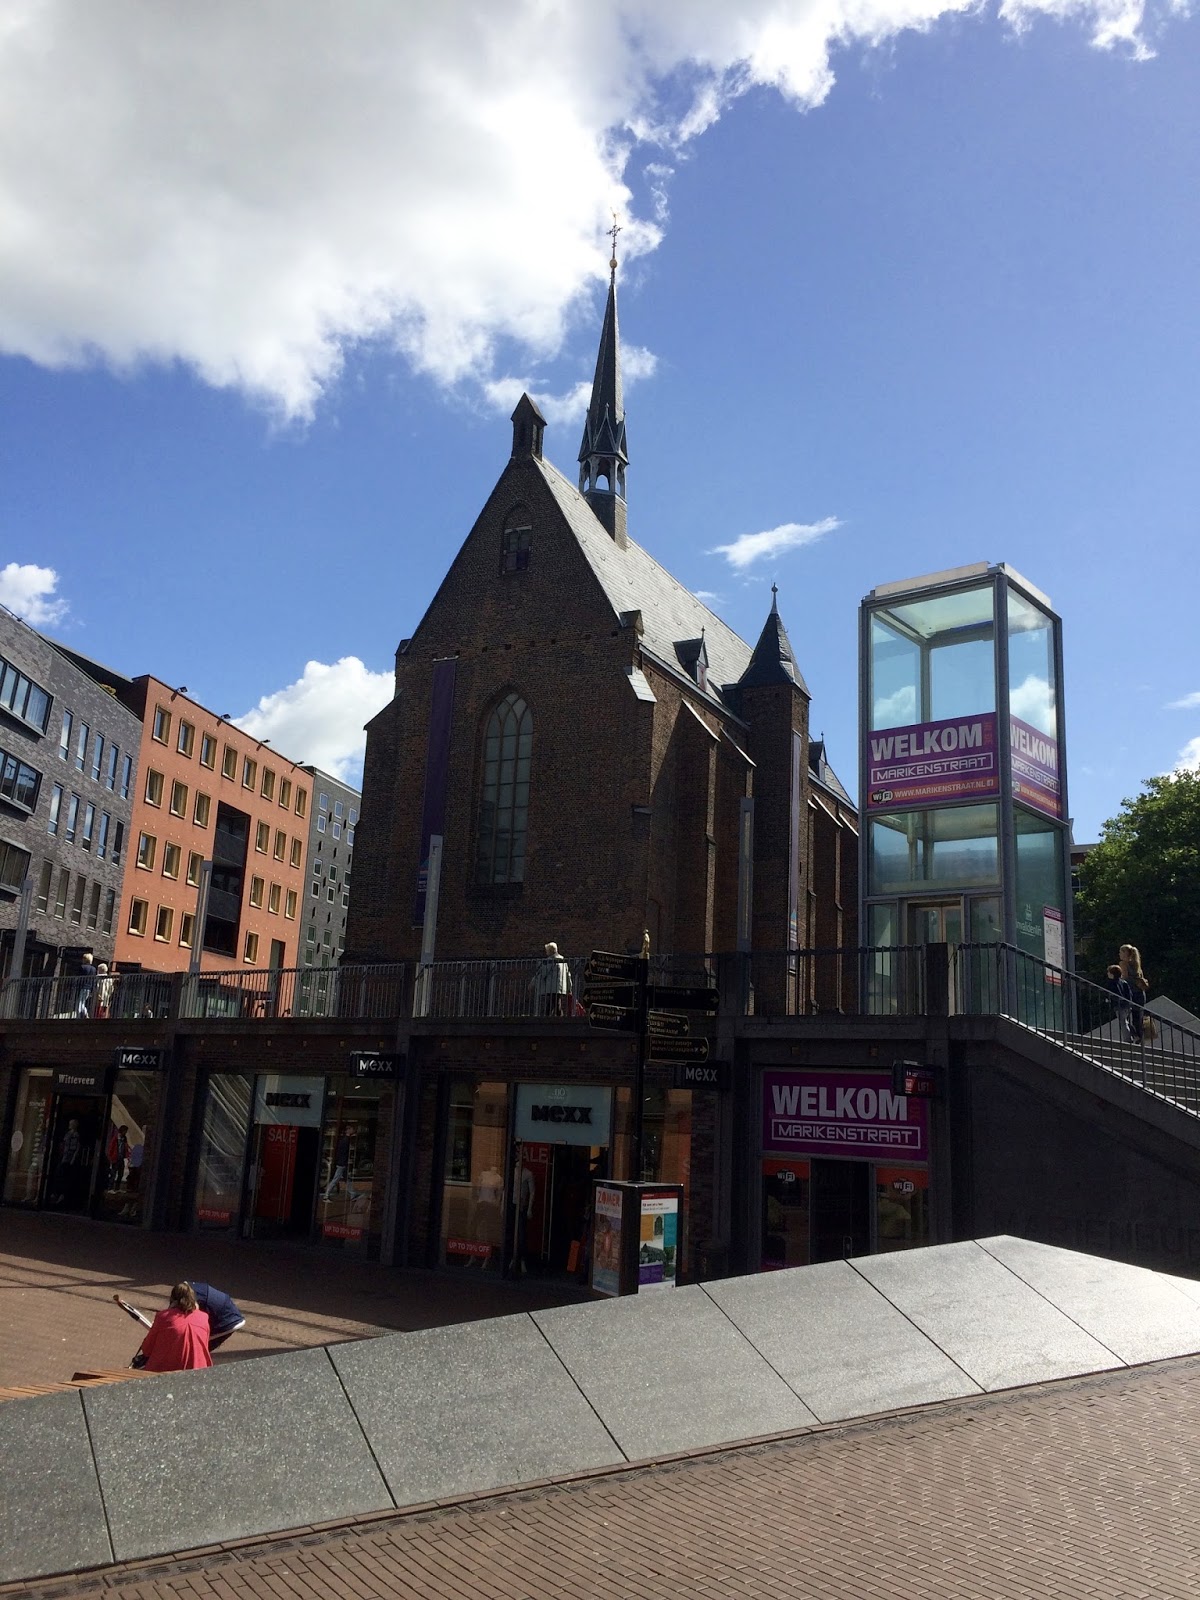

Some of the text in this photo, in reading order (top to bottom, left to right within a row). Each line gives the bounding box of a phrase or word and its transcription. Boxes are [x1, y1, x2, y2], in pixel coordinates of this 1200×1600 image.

[870, 722, 983, 761] WELKOM
[1010, 722, 1056, 771] WELKOM
[876, 756, 987, 780] MARIKENSTRAAT
[894, 782, 986, 798] WWW.MARIKENSTRAAT.NL
[58, 1074, 95, 1085] Witteveen
[772, 1084, 908, 1122] WELKOM
[268, 1127, 296, 1144] SALE
[779, 1123, 912, 1144] MARIKENSTRAAT
[449, 1241, 457, 1249] UP
[457, 1242, 466, 1250] TO
[478, 1245, 490, 1253] OFF
